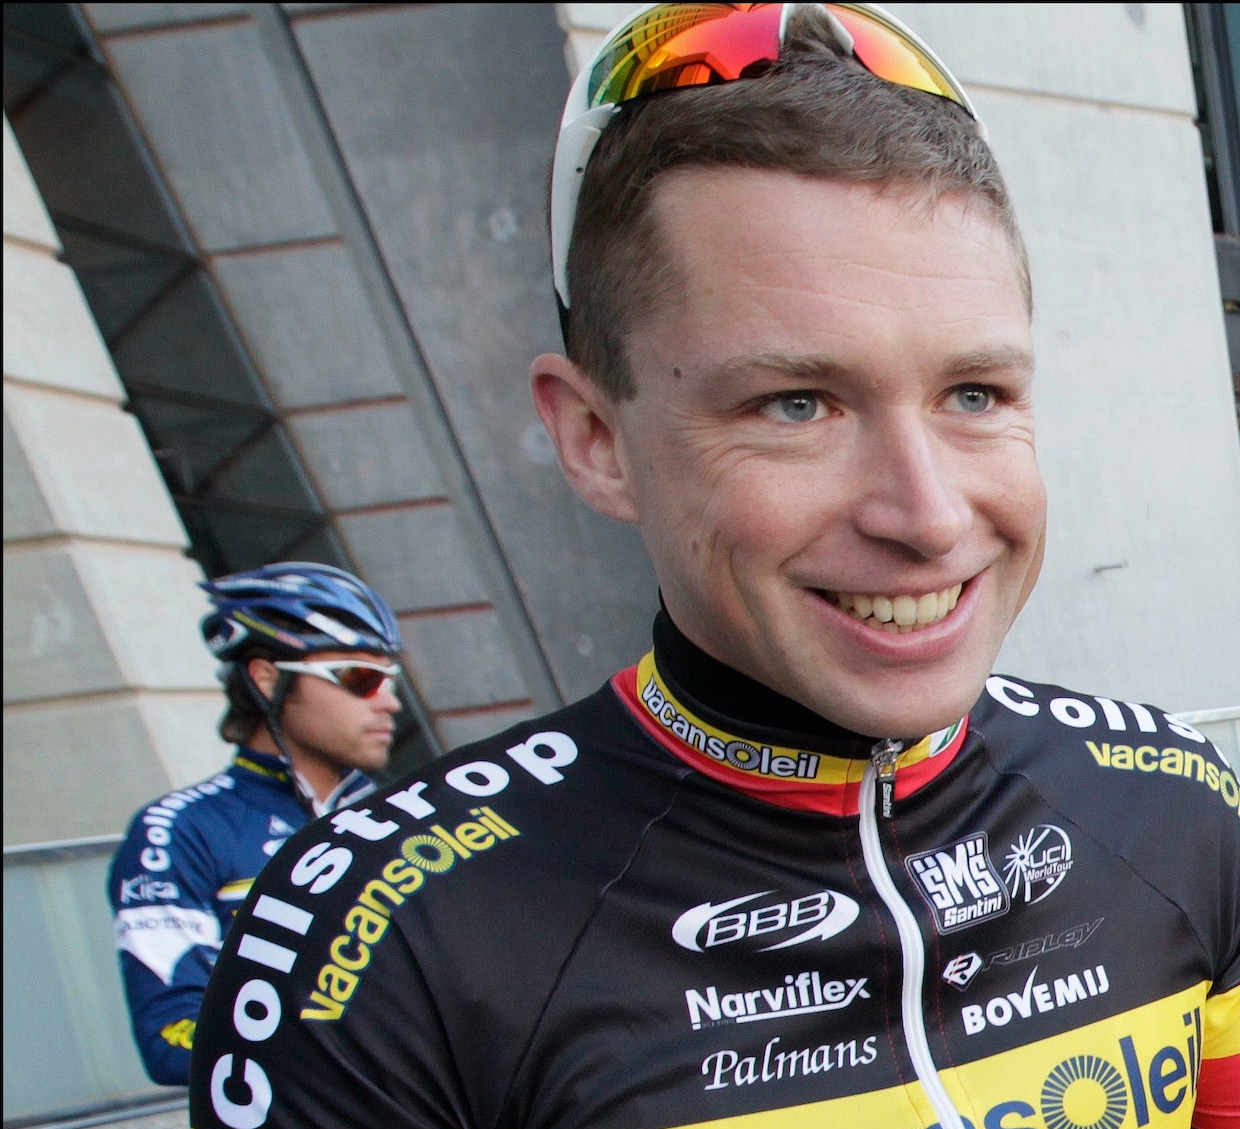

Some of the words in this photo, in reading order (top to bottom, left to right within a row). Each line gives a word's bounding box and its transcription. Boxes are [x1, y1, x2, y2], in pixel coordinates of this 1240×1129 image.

[705, 891, 829, 948] BBB
[944, 893, 1002, 927] Santini
[981, 917, 1104, 972] RIDLEY
[685, 971, 871, 1028] Narviflex
[961, 964, 1110, 1036] BOVEMIJ
[701, 1036, 877, 1091] Palmans
